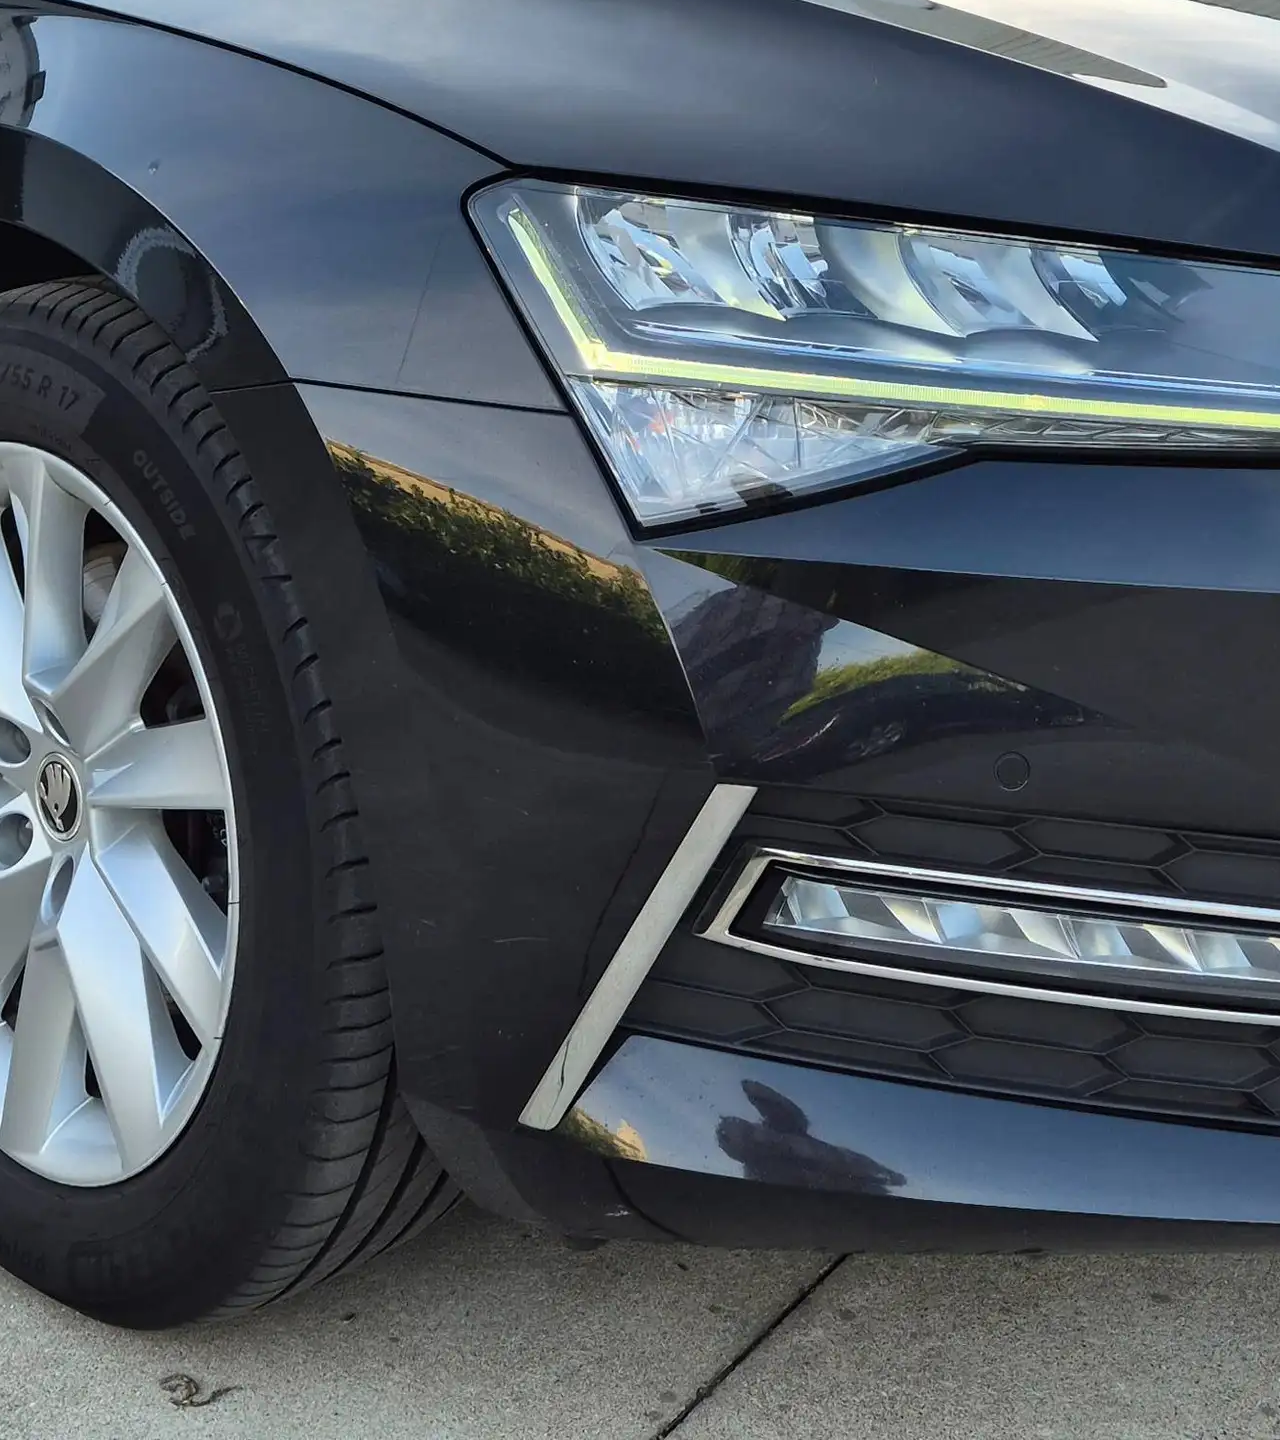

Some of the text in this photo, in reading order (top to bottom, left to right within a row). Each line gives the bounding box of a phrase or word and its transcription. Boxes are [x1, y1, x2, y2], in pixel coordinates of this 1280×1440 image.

[37, 374, 53, 399] R
[58, 385, 81, 412] 17
[133, 448, 197, 542] OUTSIDE
